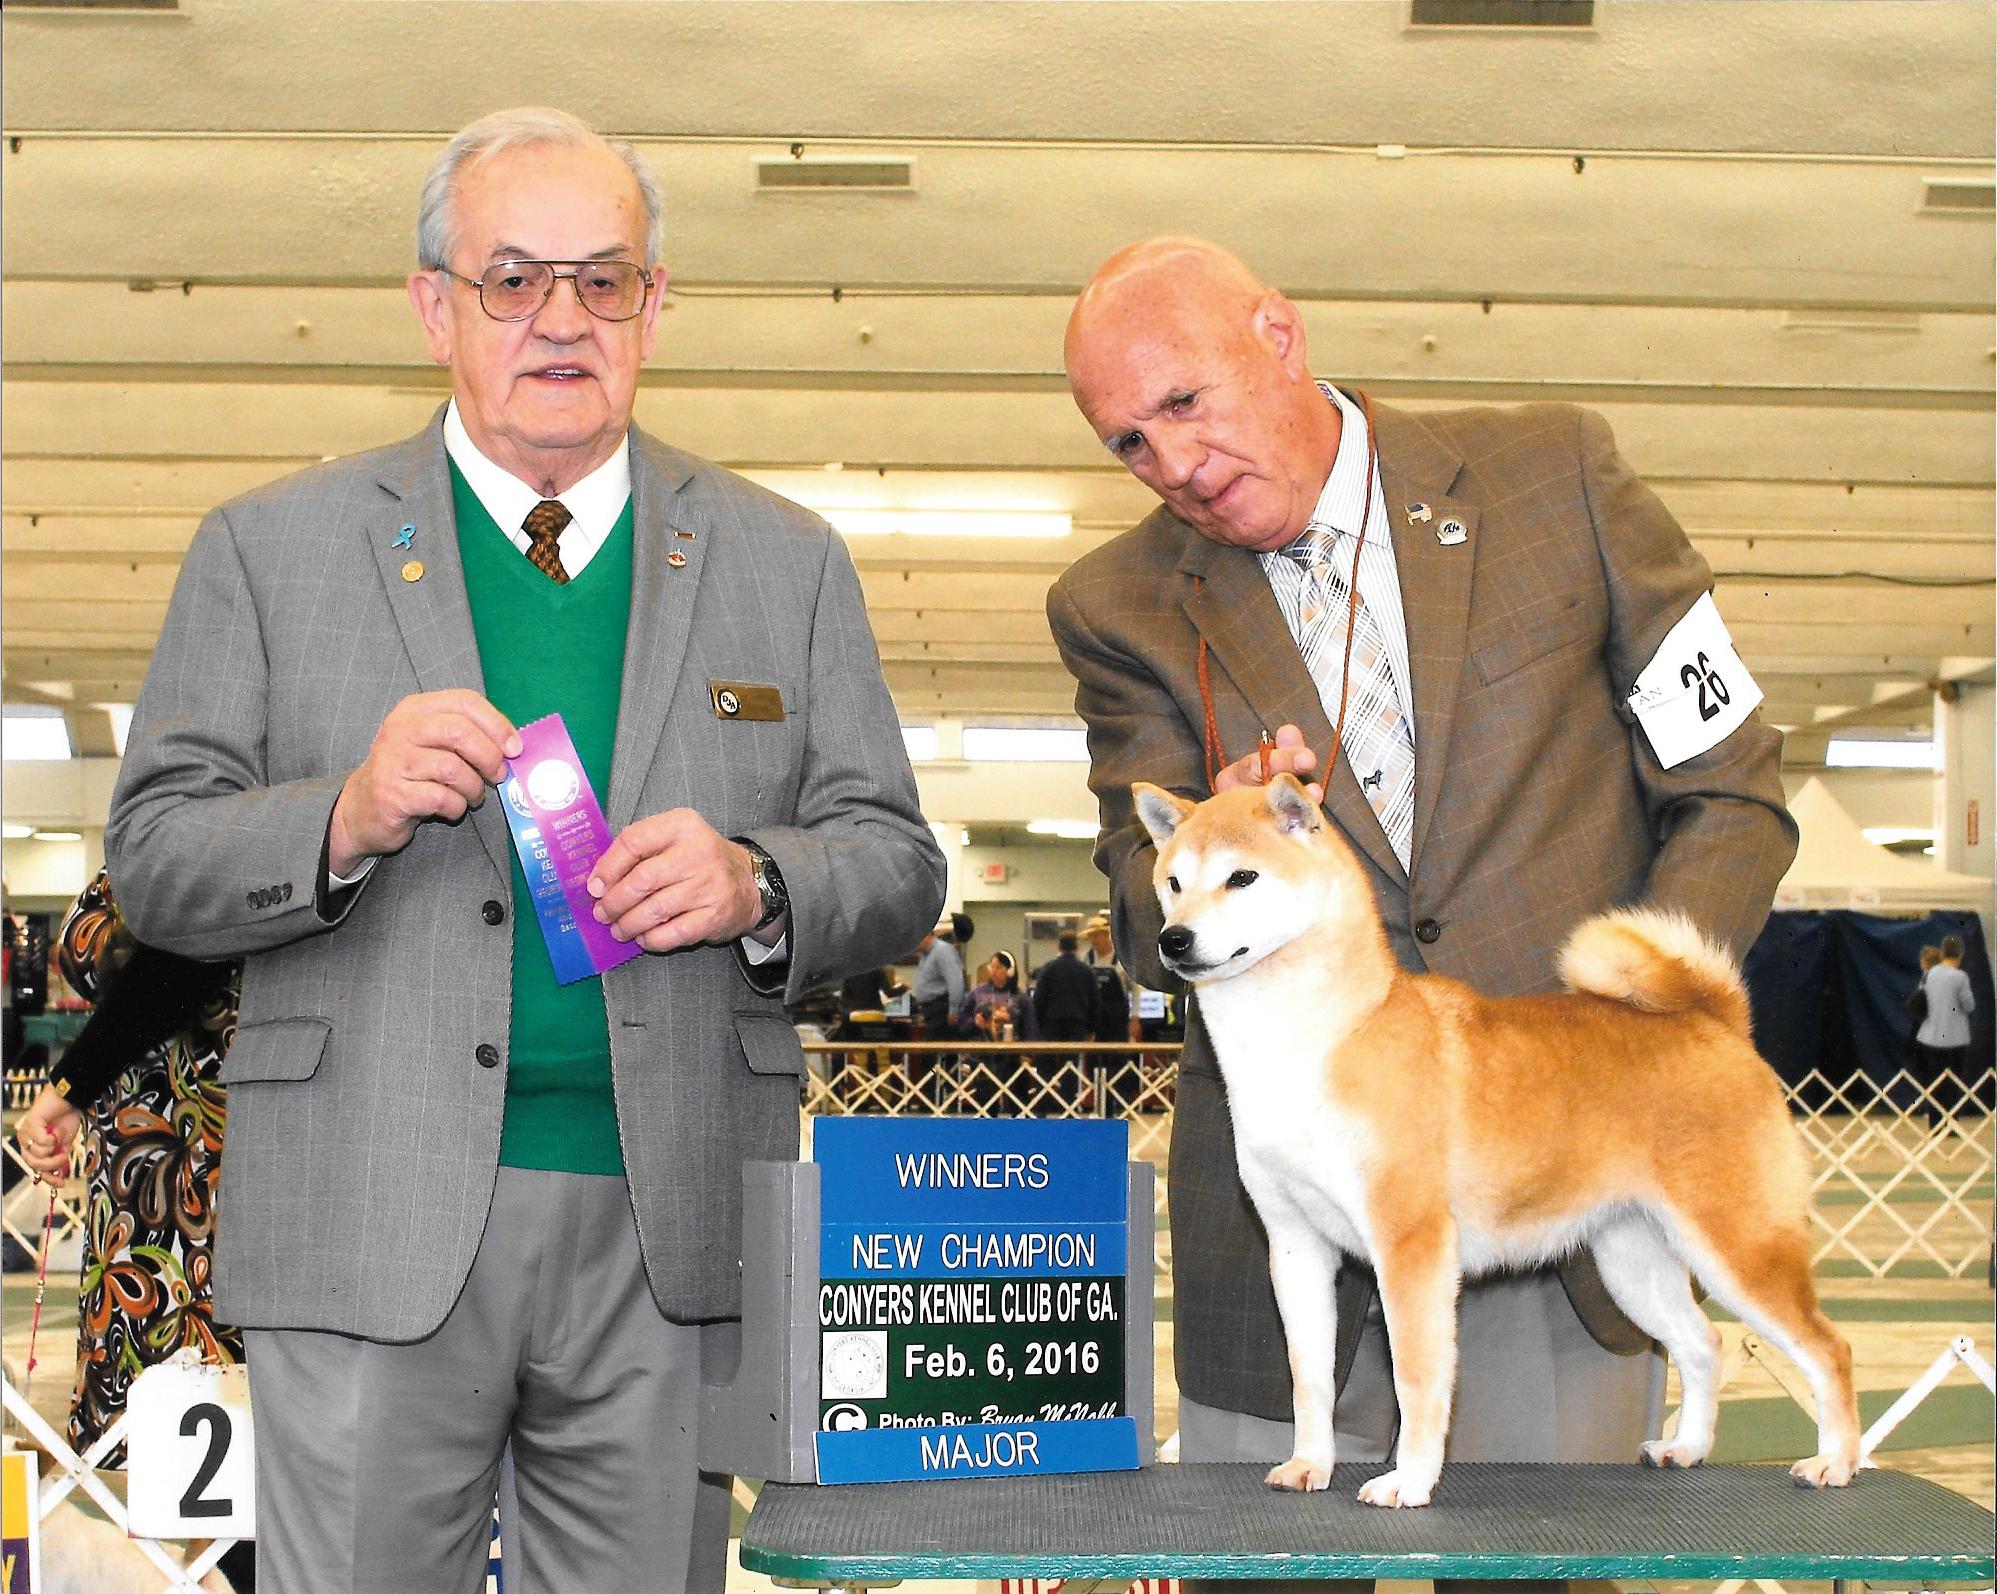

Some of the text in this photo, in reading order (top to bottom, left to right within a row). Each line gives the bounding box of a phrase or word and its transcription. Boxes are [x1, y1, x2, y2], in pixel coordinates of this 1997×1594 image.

[1680, 651, 1730, 722] 26
[895, 1153, 1049, 1188] WINNERS
[852, 1233, 1095, 1269] NEW CHAMPION
[819, 1282, 1118, 1326] CONYERS KENNEL CLUB OF GA.
[904, 1341, 1099, 1382] Feb. 6, 2016
[179, 1402, 233, 1518] 2
[920, 1430, 1040, 1470] MAJOR
